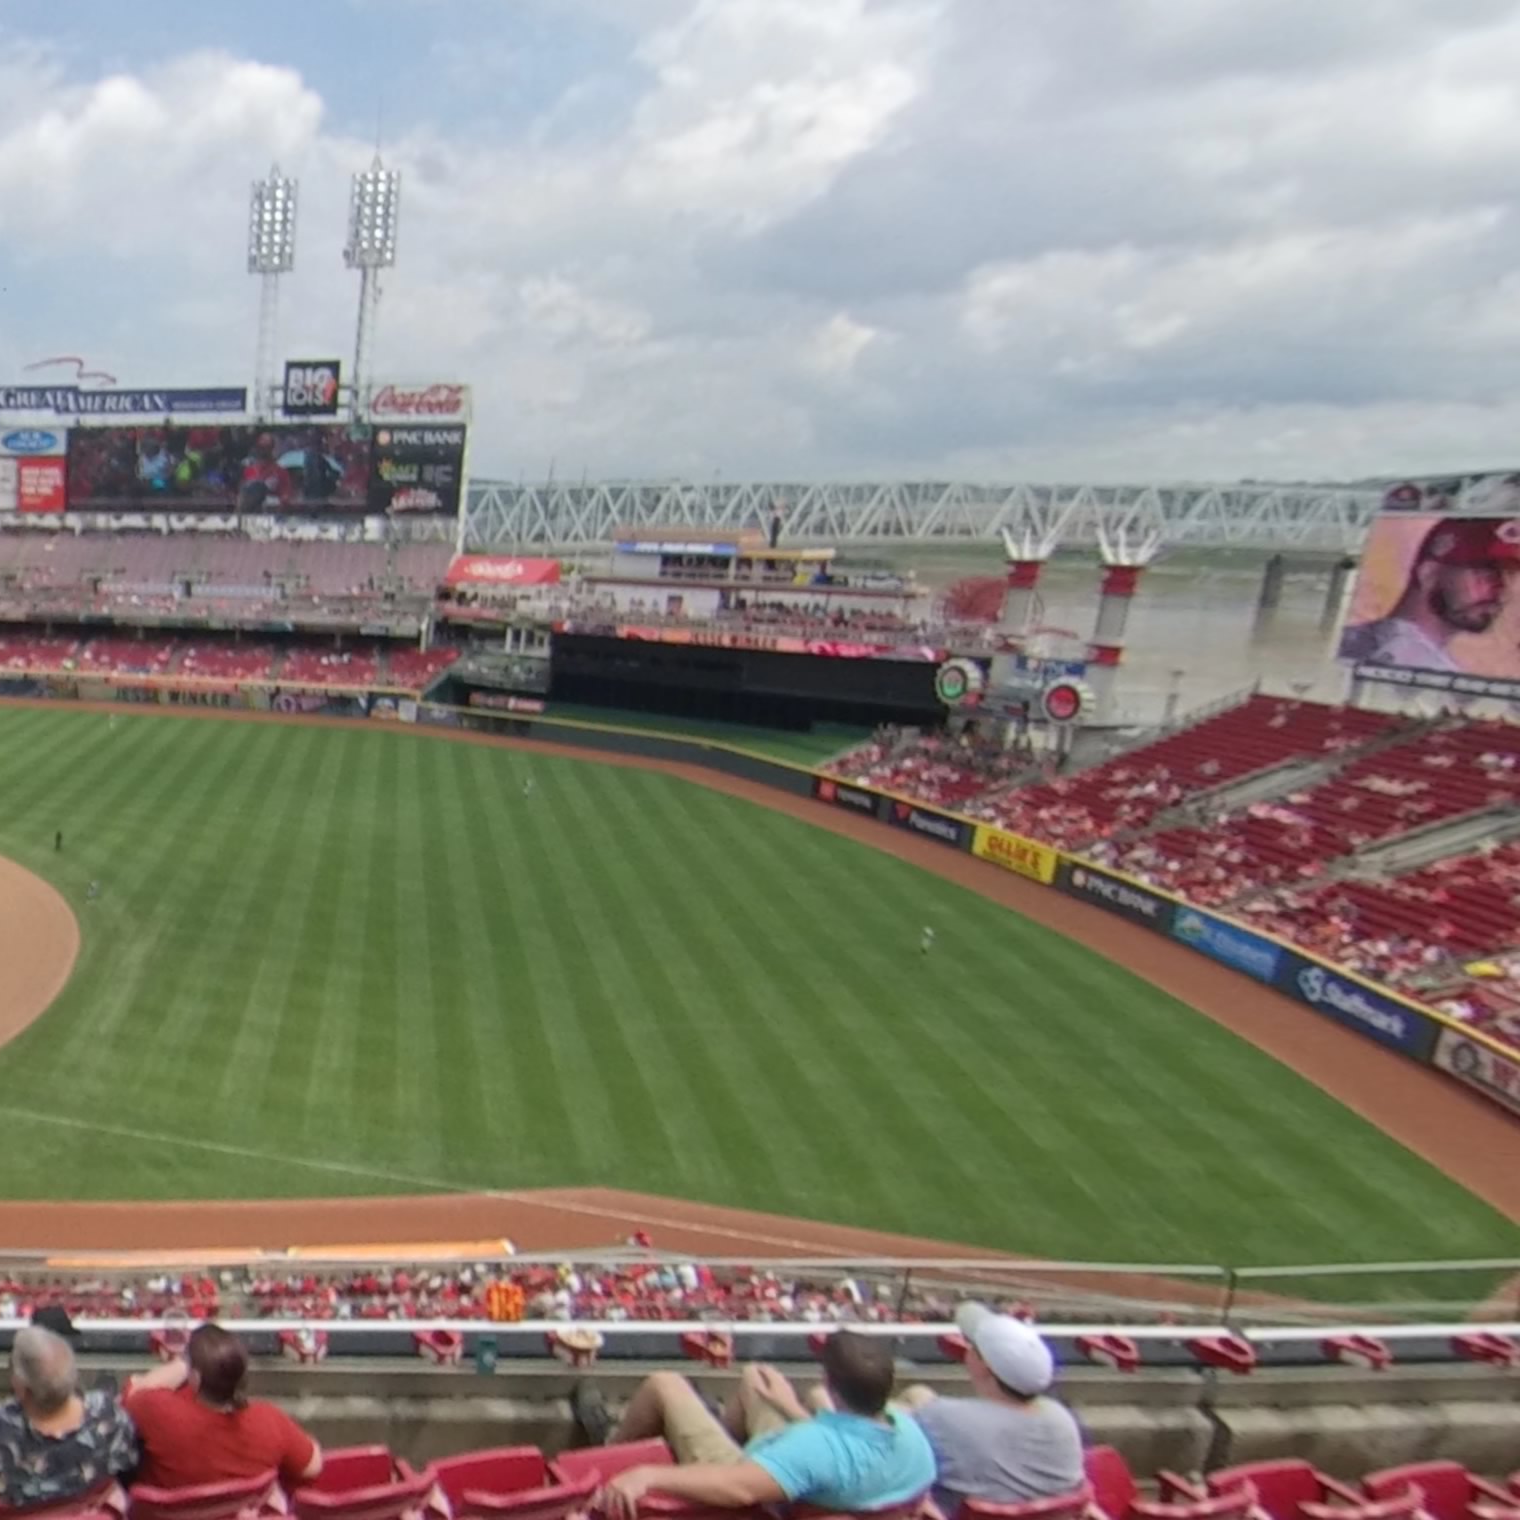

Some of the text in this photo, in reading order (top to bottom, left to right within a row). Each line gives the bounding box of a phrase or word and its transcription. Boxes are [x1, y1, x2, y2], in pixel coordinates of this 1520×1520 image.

[62, 390, 168, 412] AMERICAN
[372, 384, 464, 415] Coca-Cola
[393, 430, 462, 445] PNC BANK
